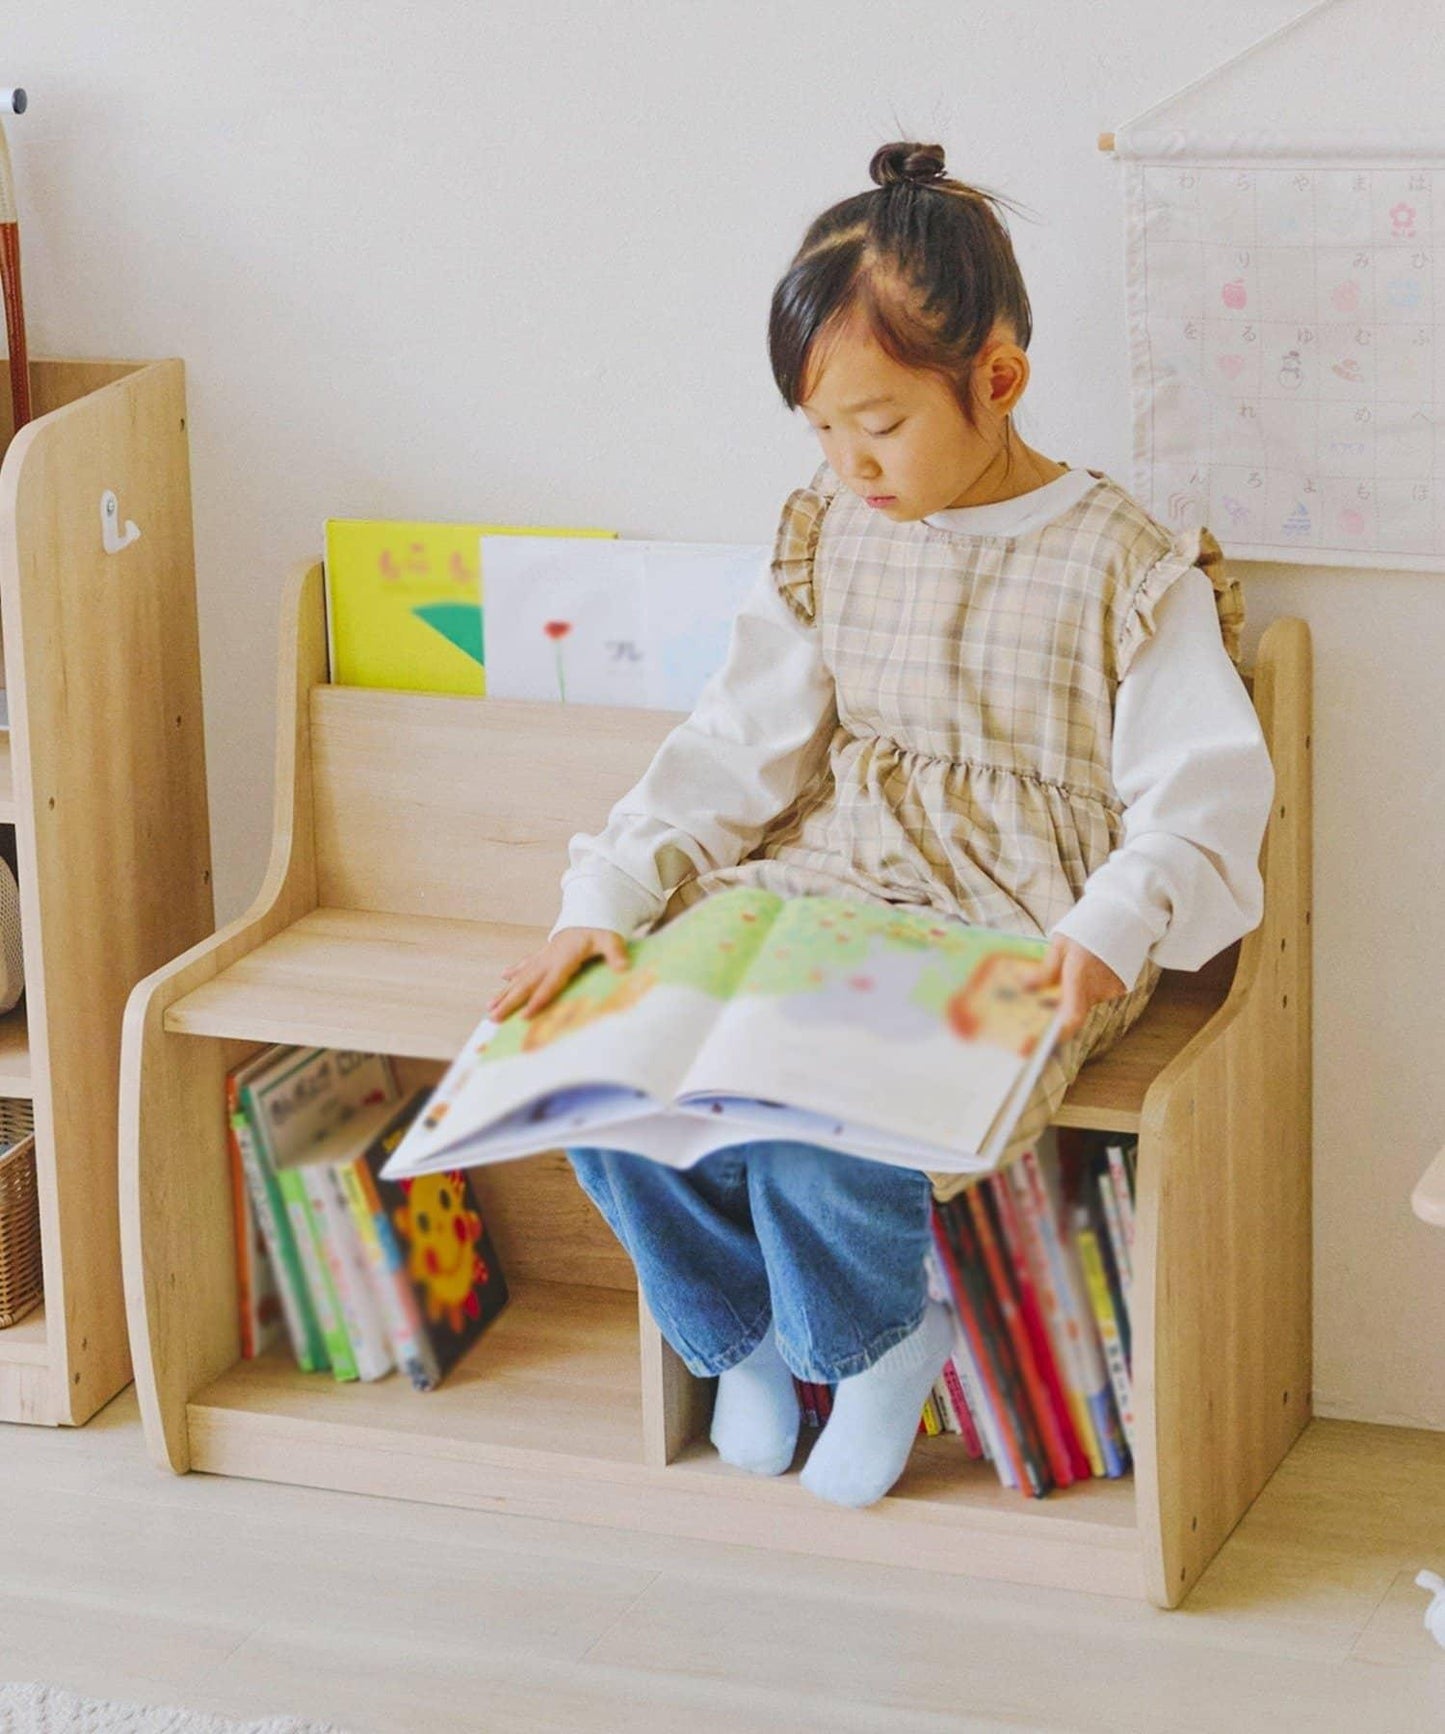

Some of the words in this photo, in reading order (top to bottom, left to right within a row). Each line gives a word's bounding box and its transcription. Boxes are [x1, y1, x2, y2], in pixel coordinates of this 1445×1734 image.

[1235, 175, 1250, 191] ら
[1291, 174, 1310, 191] や
[1353, 175, 1367, 191] ま
[1408, 175, 1427, 191] は
[1239, 252, 1250, 268] り
[1352, 253, 1369, 268] み
[1411, 253, 1429, 269] ひ
[1241, 325, 1256, 342] る
[1297, 328, 1314, 344] ゆ
[1411, 411, 1431, 423] へ
[1247, 472, 1262, 488] ろ
[1303, 478, 1316, 494] よ
[1357, 483, 1370, 500] も
